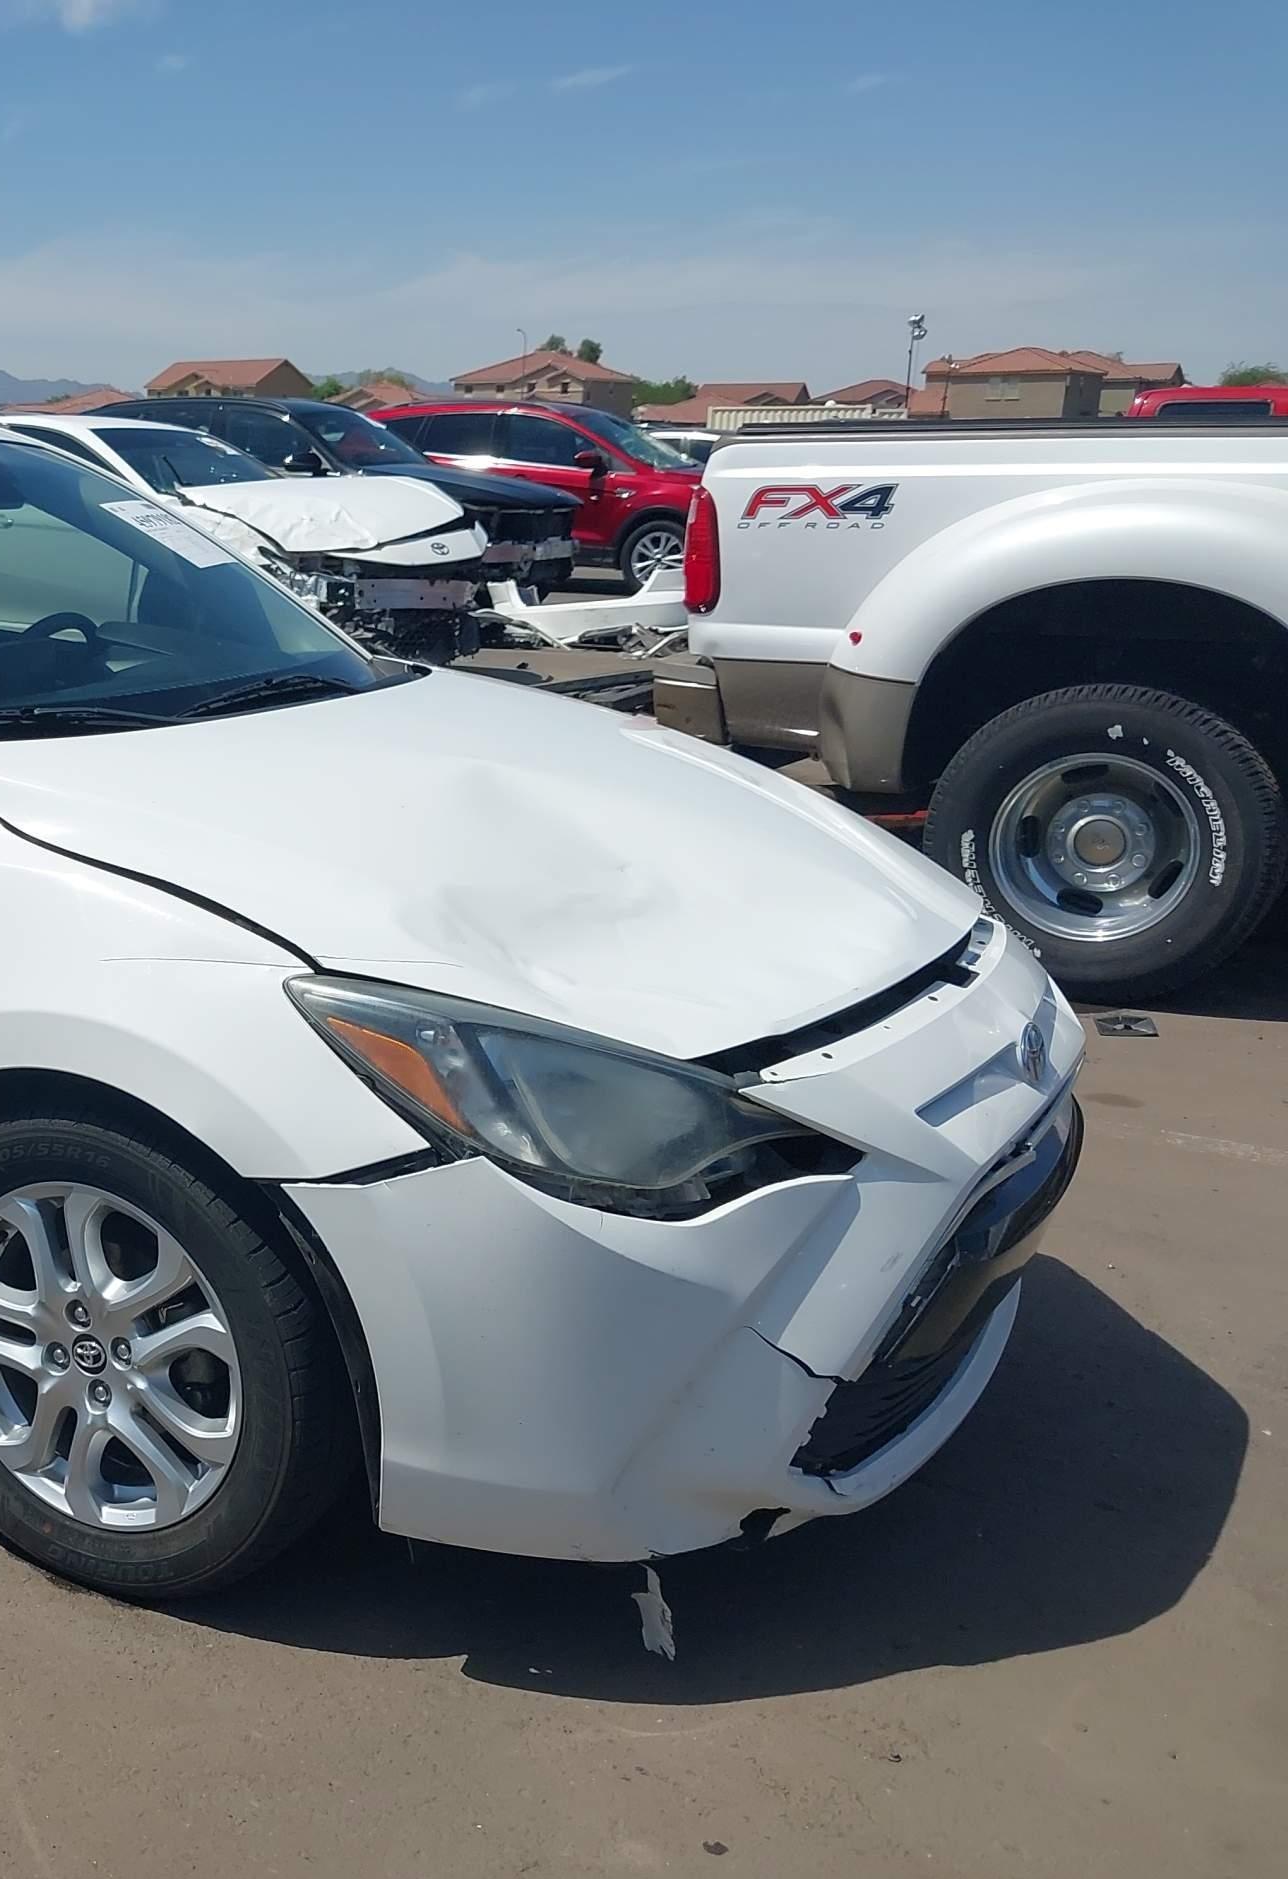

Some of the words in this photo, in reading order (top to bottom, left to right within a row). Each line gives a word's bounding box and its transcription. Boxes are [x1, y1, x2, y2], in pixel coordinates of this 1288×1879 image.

[741, 483, 899, 520] FX4
[737, 522, 792, 530] OFF
[804, 522, 886, 530] ROAD
[1166, 756, 1227, 887] MICHELIN
